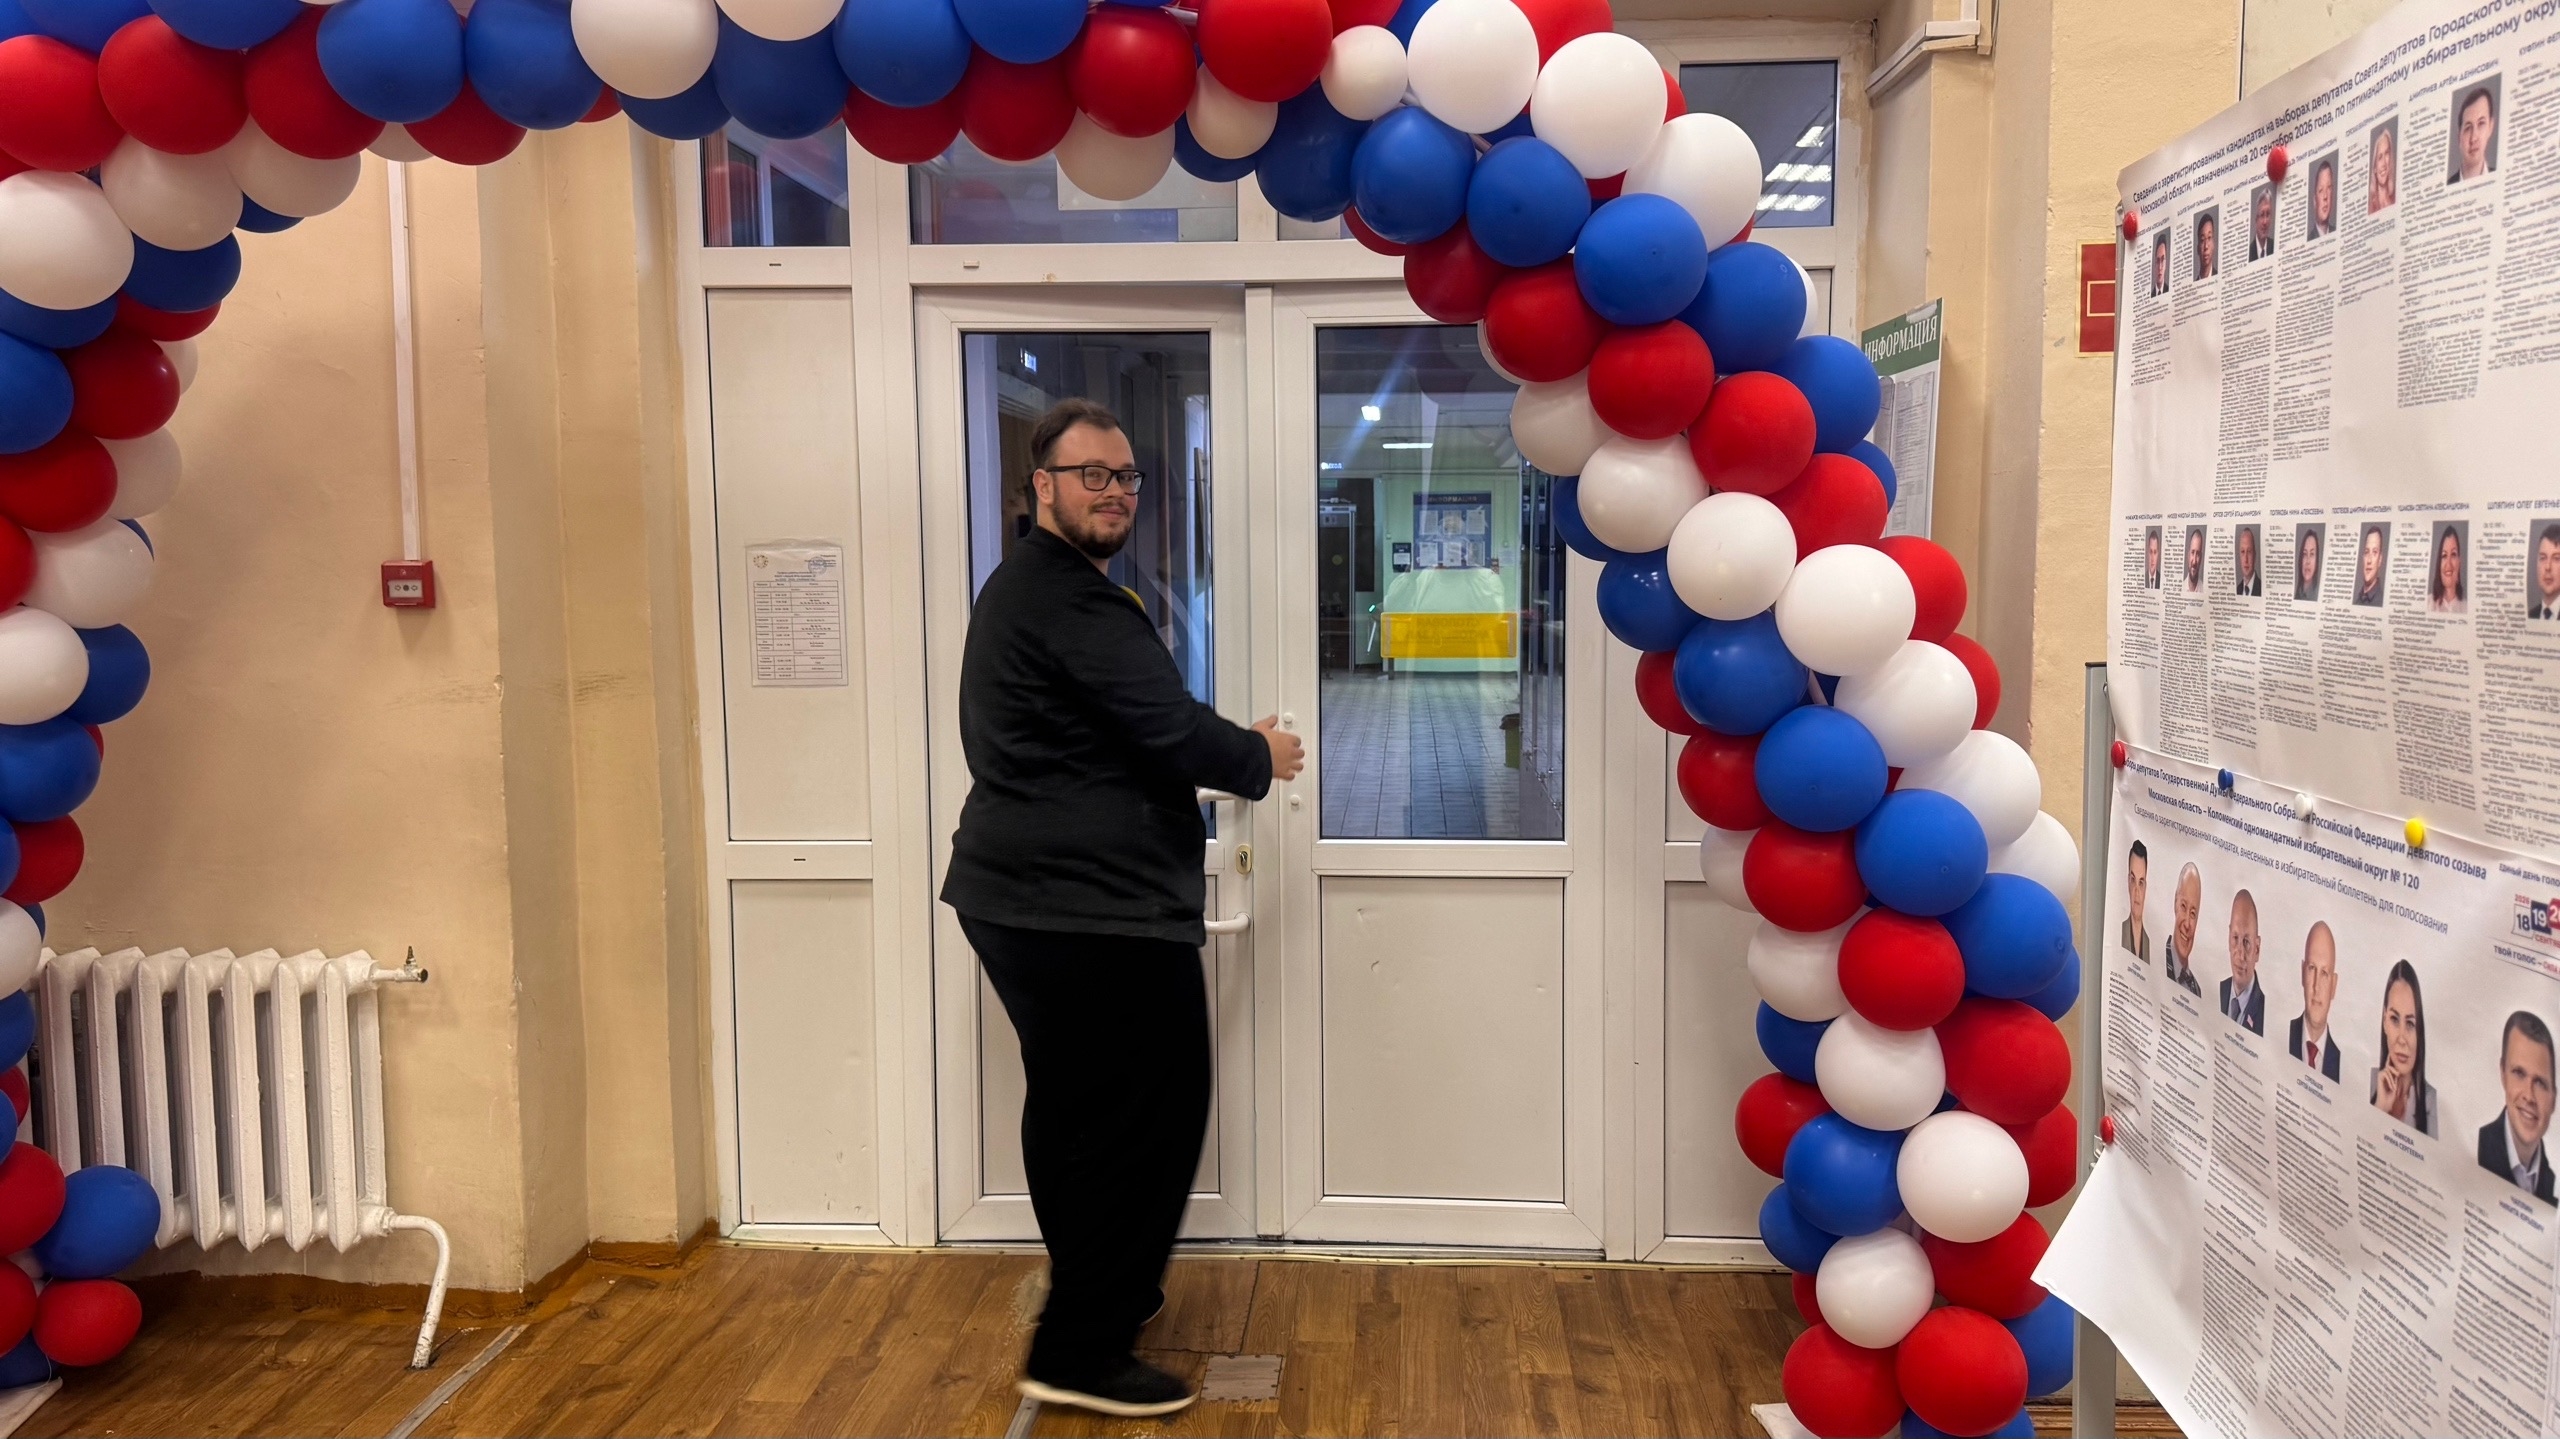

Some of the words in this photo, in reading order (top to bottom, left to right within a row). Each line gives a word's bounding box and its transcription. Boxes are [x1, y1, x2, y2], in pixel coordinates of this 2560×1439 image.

[2133, 184, 2157, 203] Сведения
[2162, 150, 2226, 188] зарегистрированных
[2226, 128, 2266, 154] кандидатах
[2266, 120, 2275, 134] на
[2275, 102, 2315, 128] выборах
[2312, 78, 2353, 110] депутатов
[2354, 60, 2378, 86] Совета
[2378, 33, 2426, 70] депутатов
[2429, 0, 2502, 42] Городского
[2140, 191, 2168, 216] Московской
[2168, 181, 2192, 201] области,
[2193, 160, 2239, 188] назначенных
[2240, 154, 2248, 165] на
[2250, 148, 2258, 162] 20
[2294, 118, 2313, 140] 2026
[2314, 110, 2334, 132] года,
[2335, 106, 2346, 119] по
[2346, 64, 2410, 112] пятимандатному
[2412, 14, 2522, 74] избирательному
[1865, 315, 1938, 363] ИНФОРМАЦИЯ
[2134, 803, 2154, 820] Сведения
[2158, 815, 2212, 842] зарегистрированных
[2212, 836, 2240, 856] кандидатах,
[2240, 847, 2274, 868] внесенных
[2280, 862, 2336, 890] избирательный
[2337, 879, 2378, 907] бюллетень
[2378, 898, 2394, 912] для
[2395, 904, 2448, 934] голосования
[2136, 764, 2160, 778] депутатов
[2160, 768, 2209, 793] Государственной
[2312, 812, 2353, 838] Российской
[2354, 826, 2406, 854] Федерации
[2406, 845, 2450, 868] девятого
[2452, 858, 2487, 880] созыва
[2148, 787, 2178, 807] Московская
[2178, 798, 2203, 815] область
[2208, 806, 2243, 830] Коломенский
[2244, 820, 2302, 850] одномандатный
[2304, 841, 2363, 872] избирательный
[2364, 862, 2389, 882] округ
[2390, 868, 2400, 882] №
[2402, 872, 2420, 890] 120
[2522, 870, 2540, 882] ДЕНЬ
[2516, 913, 2530, 932] 18
[2532, 908, 2548, 928] 19
[2550, 904, 2560, 922] 2
